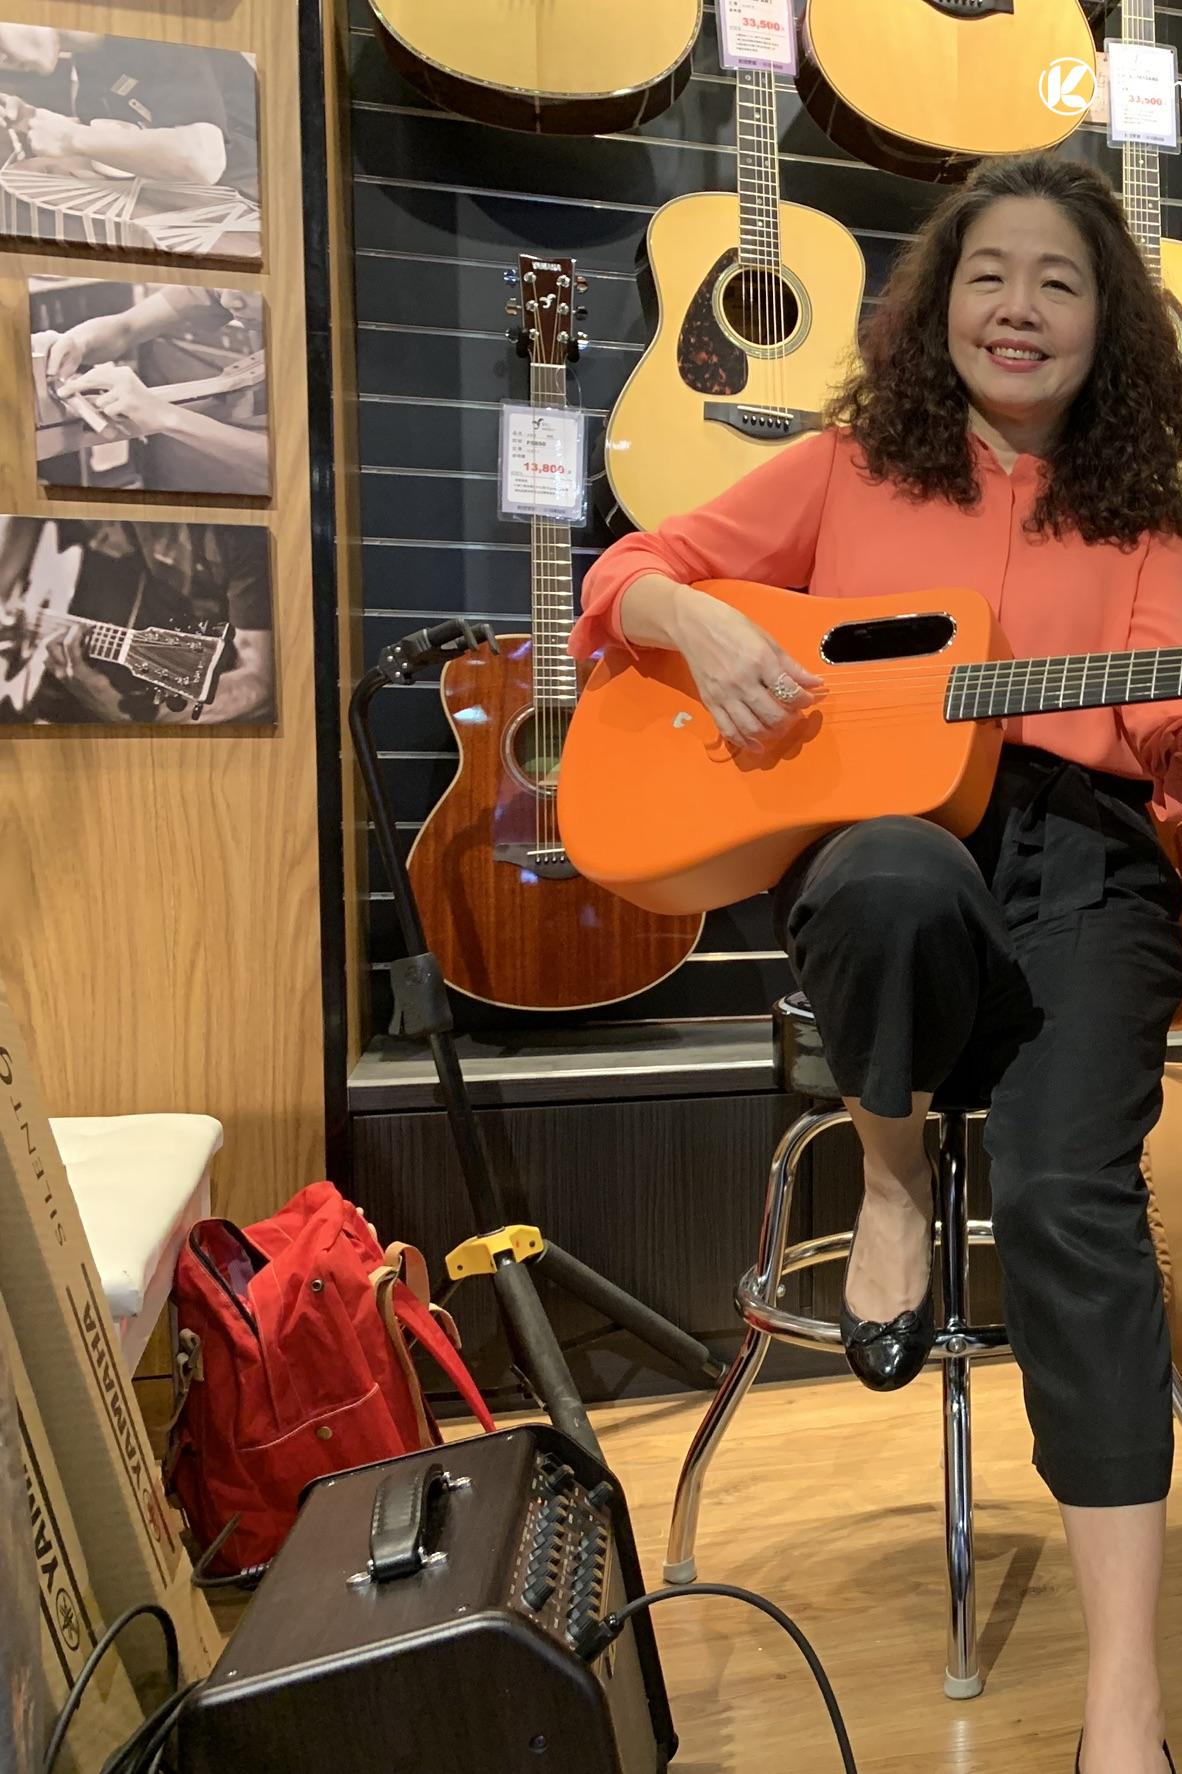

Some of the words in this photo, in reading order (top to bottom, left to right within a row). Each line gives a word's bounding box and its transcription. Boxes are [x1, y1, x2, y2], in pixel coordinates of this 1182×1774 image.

[523, 461, 566, 475] 13,800
[9, 1094, 67, 1248] SILENT
[82, 1299, 142, 1491] YAMAHA
